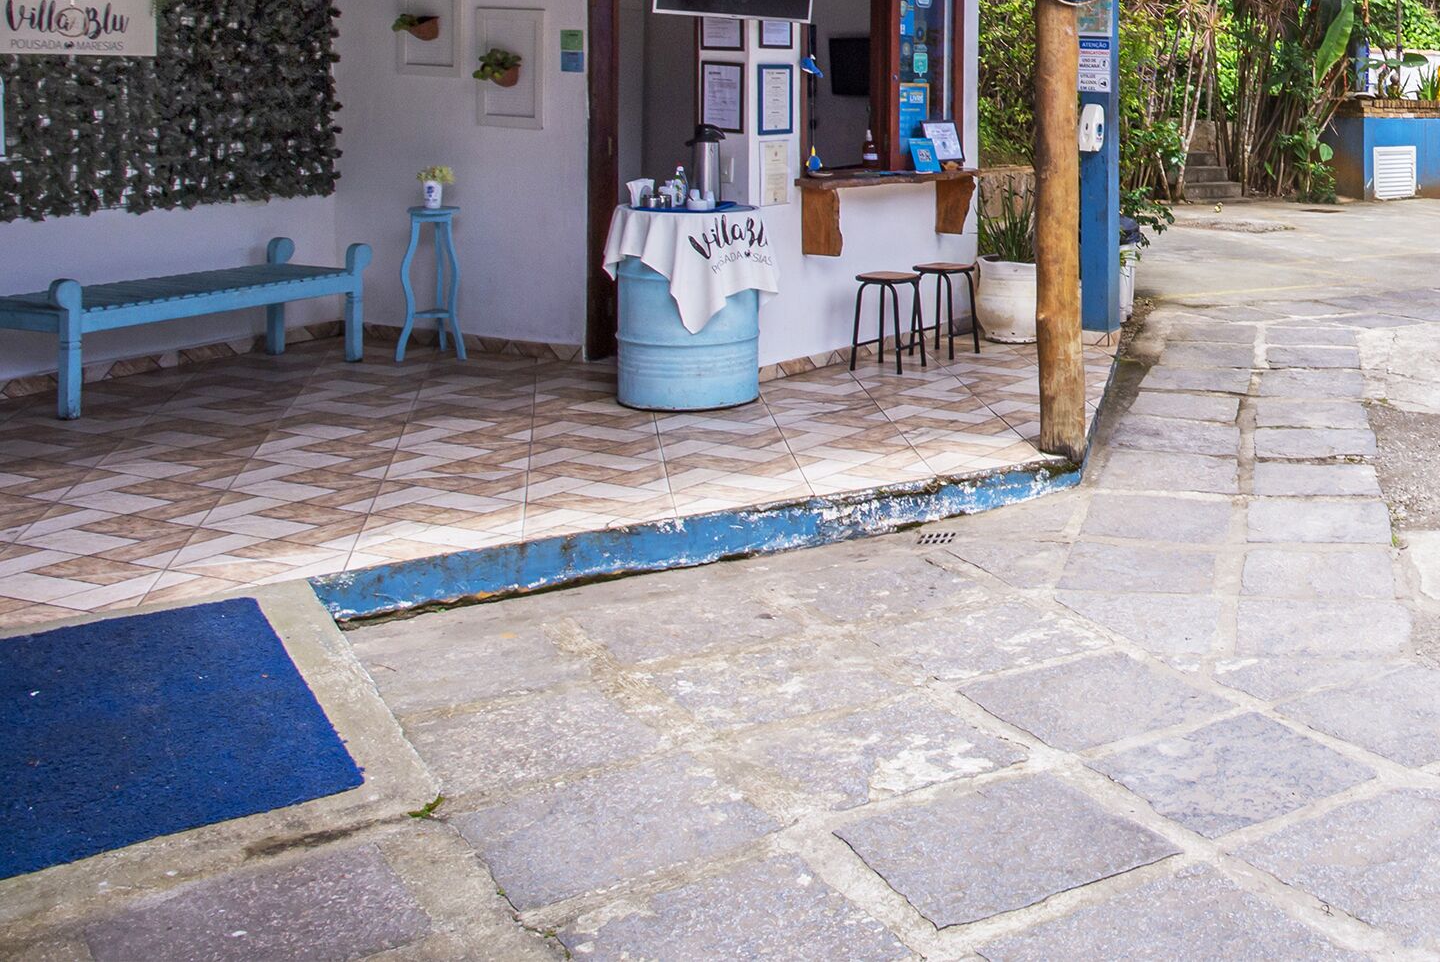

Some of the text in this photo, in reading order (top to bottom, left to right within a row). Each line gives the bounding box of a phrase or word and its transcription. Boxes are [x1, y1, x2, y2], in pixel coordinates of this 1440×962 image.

[84, 2, 129, 40] Blu
[11, 39, 124, 51] POUSADA MARESIAS
[1081, 40, 1108, 49] ATENÇÃO
[687, 214, 745, 260] Villa
